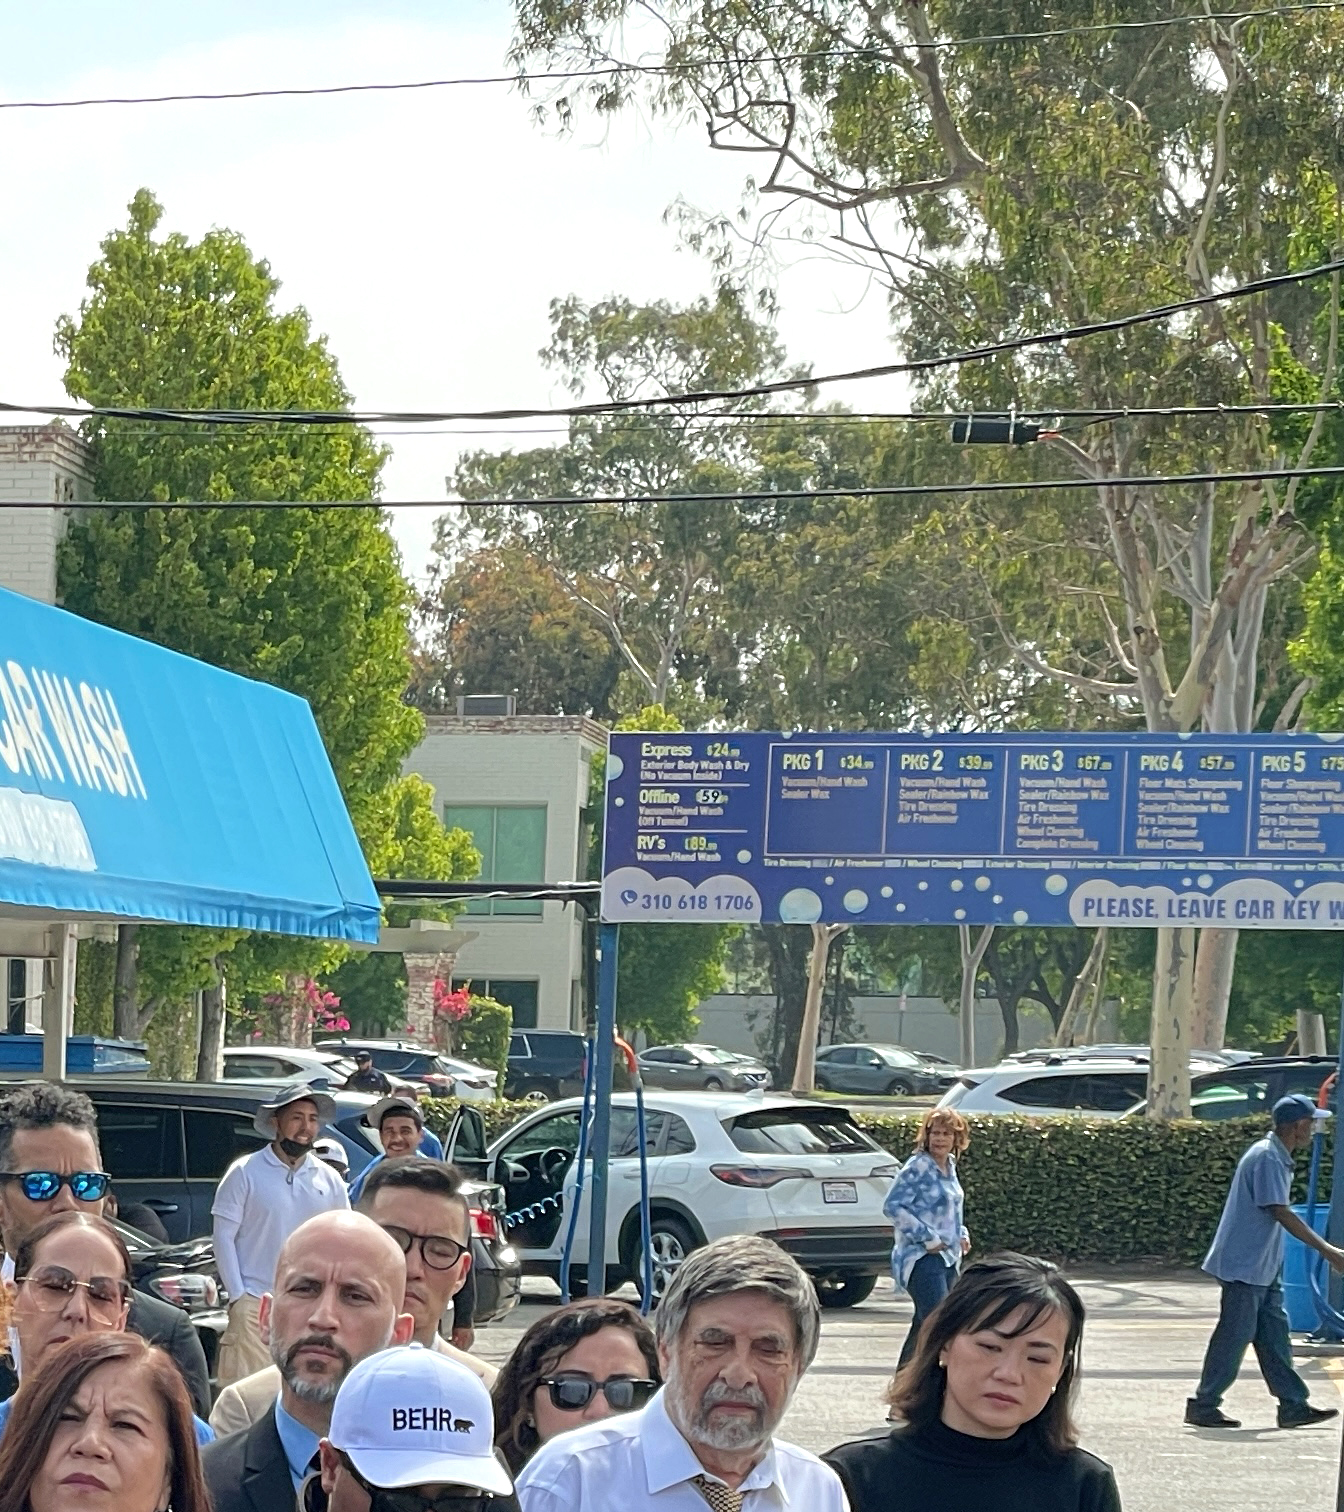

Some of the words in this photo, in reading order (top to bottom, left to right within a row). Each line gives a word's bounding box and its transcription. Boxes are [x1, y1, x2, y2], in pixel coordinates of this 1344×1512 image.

[31, 666, 148, 800] WASH
[641, 742, 693, 759] Express
[783, 754, 811, 770] PKG
[815, 749, 824, 770] 1
[901, 754, 929, 770] PKG
[932, 749, 944, 771] 2
[1021, 754, 1049, 770] PKG
[1052, 750, 1064, 771] 3
[734, 760, 750, 772] Dry
[1140, 755, 1169, 771] PKG
[1172, 751, 1184, 772] 4
[1262, 755, 1291, 771] PKG
[1294, 751, 1306, 772] 5
[639, 789, 680, 804] Offline
[637, 835, 666, 850] RV's
[642, 894, 672, 910] 310
[678, 895, 708, 910] 618
[714, 895, 754, 911] 1706
[1167, 898, 1226, 918] LEAVE
[1235, 899, 1274, 919] CAR
[1283, 899, 1320, 920] KEY
[392, 1407, 452, 1432] BEHR
